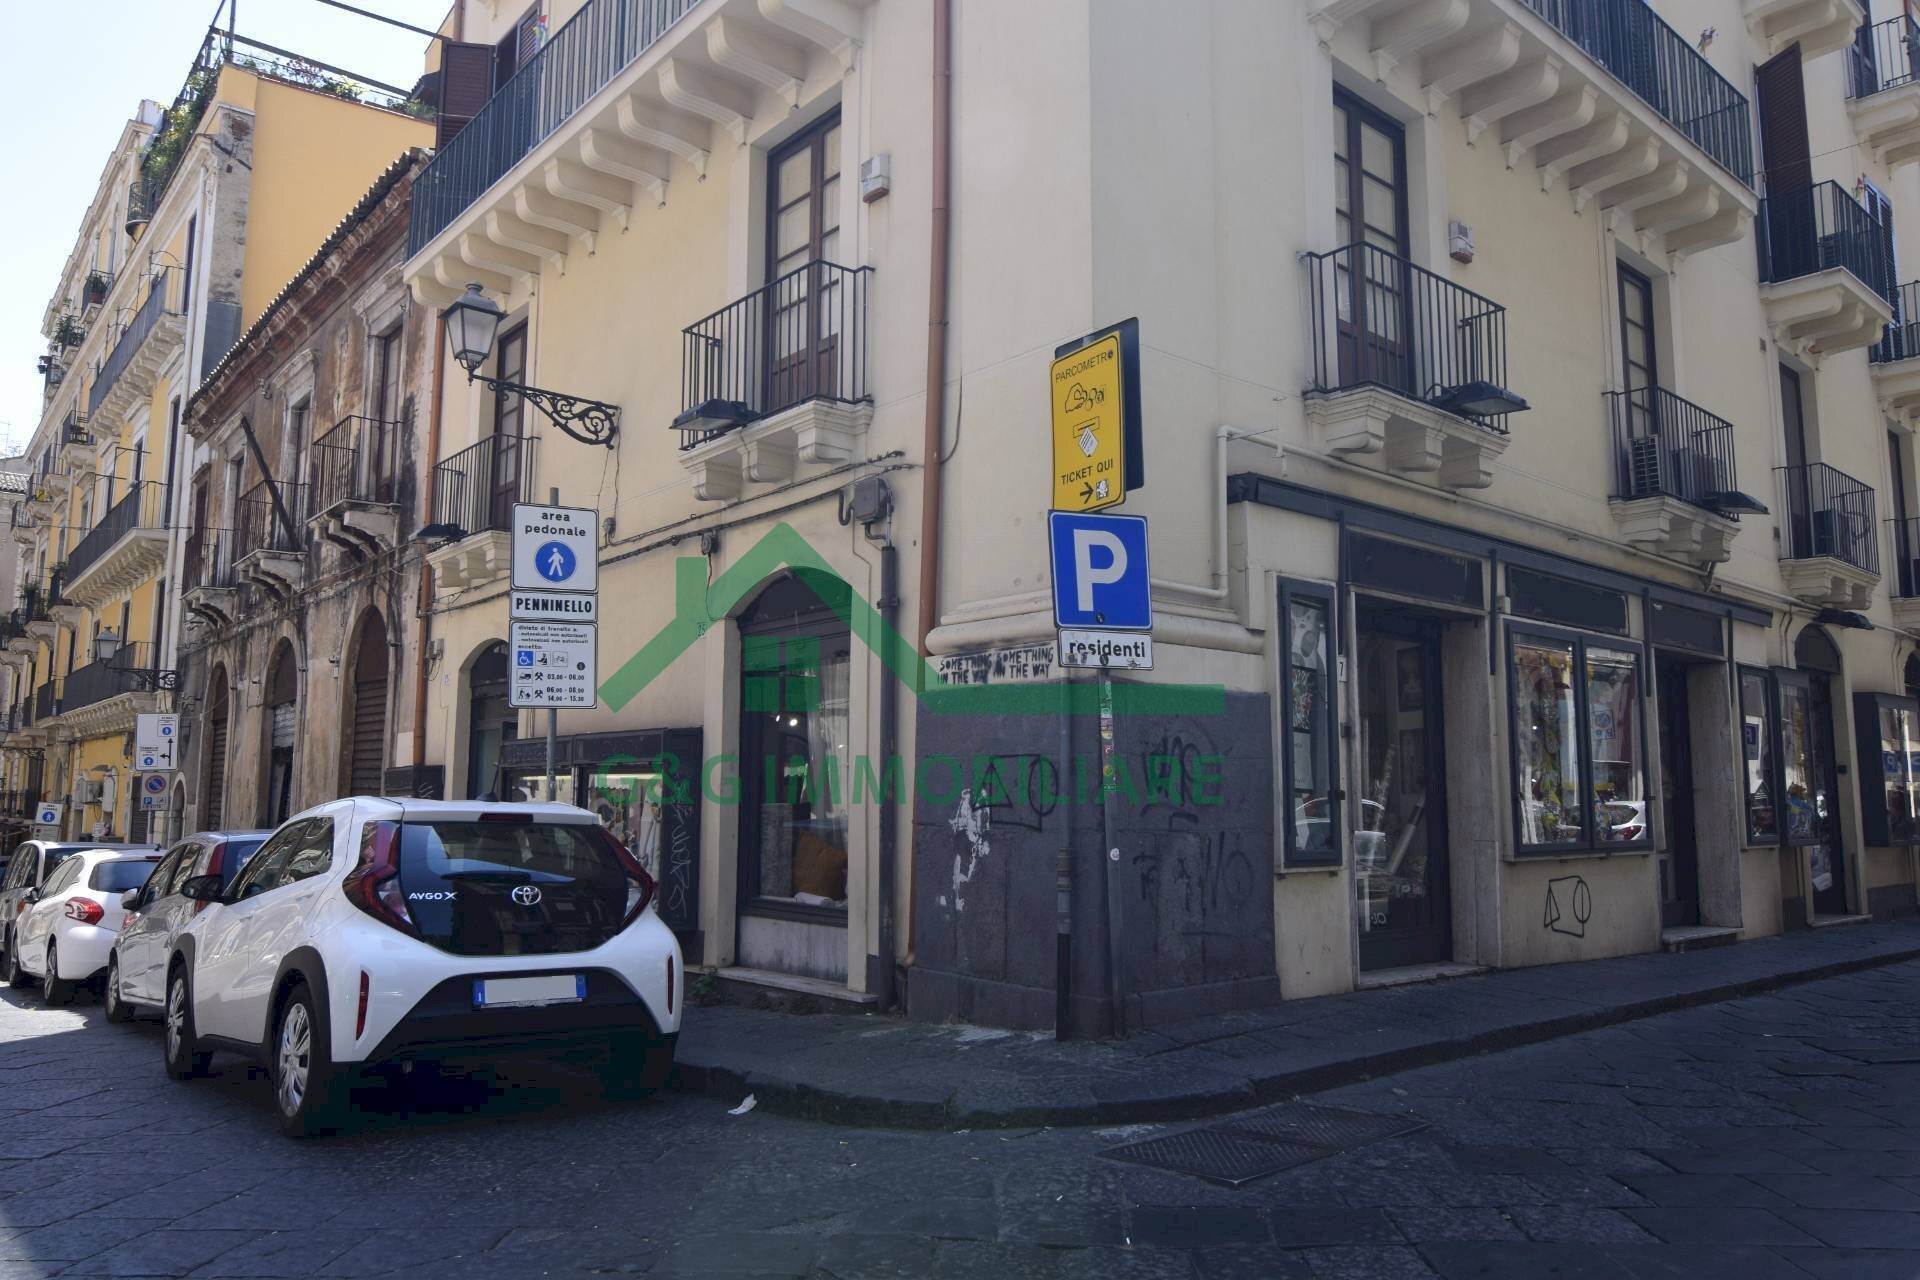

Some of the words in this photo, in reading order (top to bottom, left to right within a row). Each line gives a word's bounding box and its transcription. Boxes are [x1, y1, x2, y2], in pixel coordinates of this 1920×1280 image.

[1056, 350, 1113, 384] PARCOMETR
[1061, 465, 1093, 485] TICKET
[1097, 458, 1113, 473] QUI
[541, 512, 570, 522] area
[525, 525, 586, 537] pedonale
[1074, 528, 1128, 612] P
[516, 598, 592, 613] PENNINELLO
[996, 646, 1054, 663] SOMETHING
[1069, 640, 1145, 658] residenti
[940, 653, 992, 672] SOMETHING
[951, 670, 969, 684] THE
[1009, 664, 1029, 679] THE
[1033, 663, 1050, 678] WAY
[408, 892, 443, 900] AYGO
[444, 891, 458, 900] X
